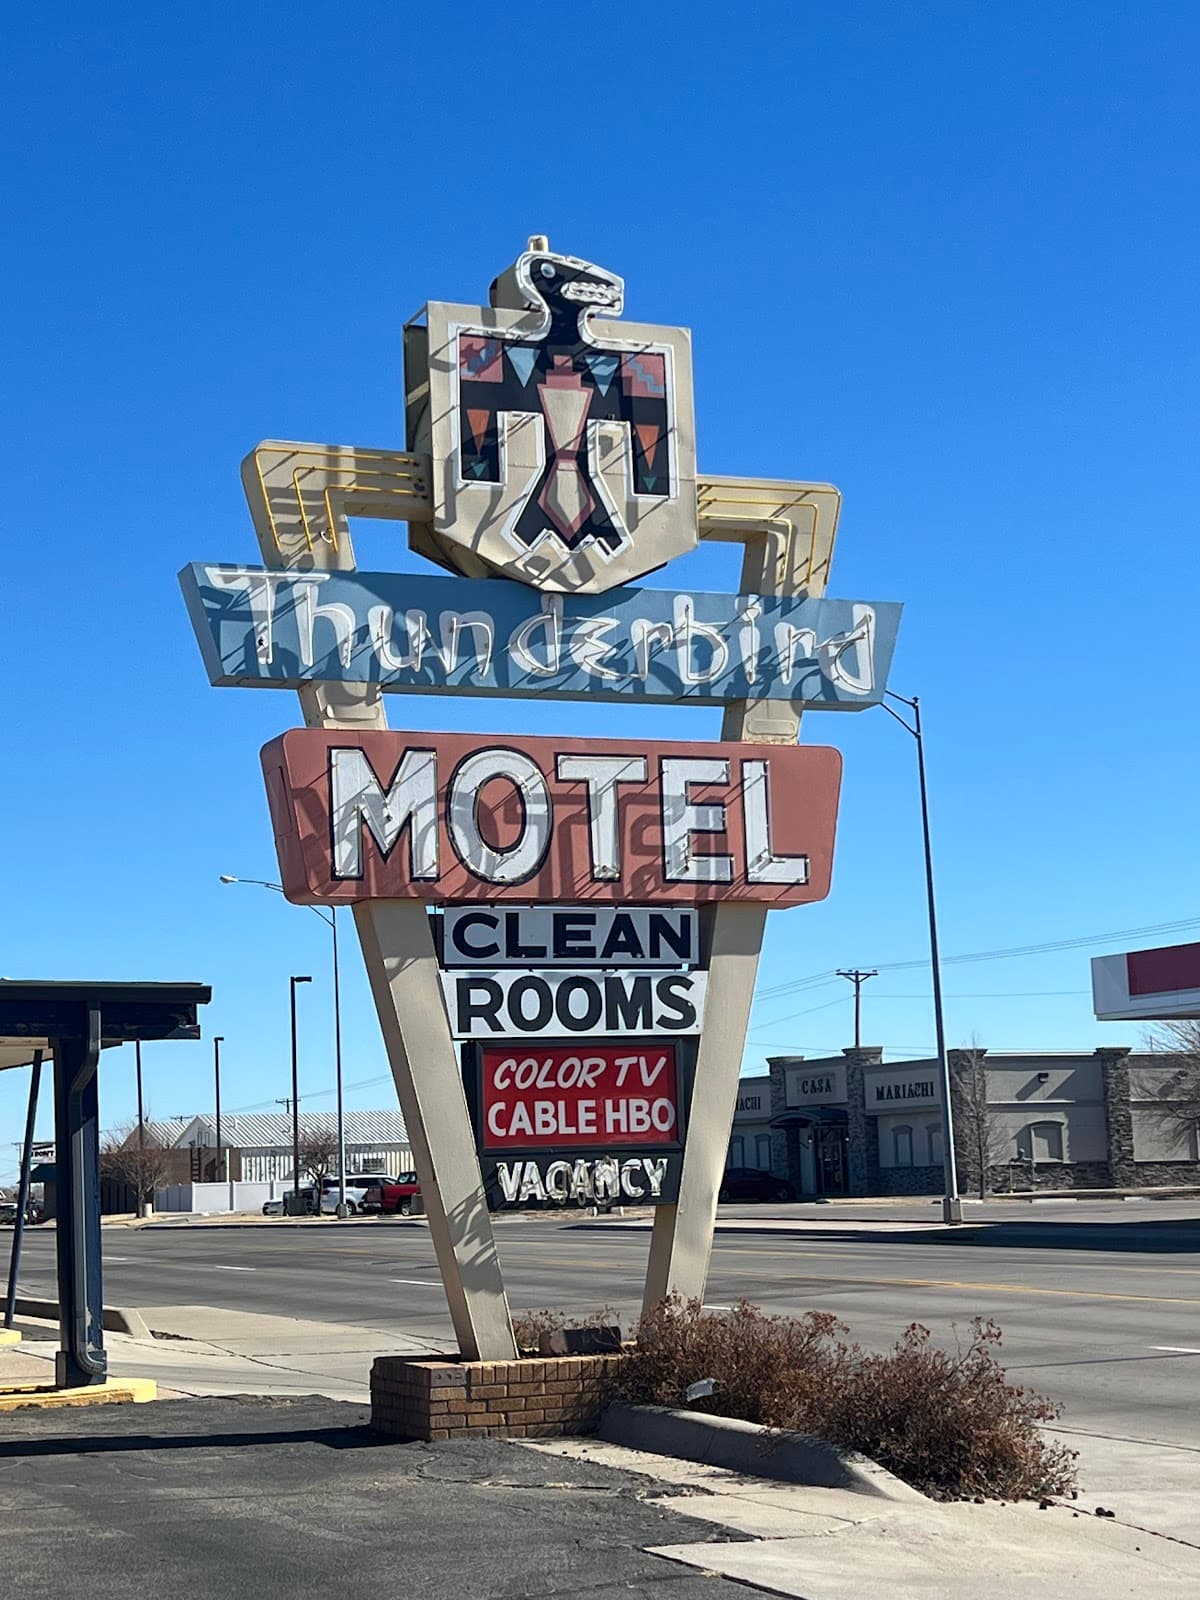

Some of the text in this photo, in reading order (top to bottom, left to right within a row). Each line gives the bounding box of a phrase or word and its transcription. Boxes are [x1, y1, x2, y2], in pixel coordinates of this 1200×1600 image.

[203, 566, 878, 694] Thunderbird
[329, 746, 809, 884] MOTEL
[452, 912, 691, 959] CLEAN
[456, 975, 697, 1033] ROOMS
[493, 1056, 667, 1090] COLOR TV
[802, 1078, 832, 1095] CASA
[876, 1081, 934, 1100] MARIACHI
[487, 1097, 676, 1137] CABLE HBO
[496, 1158, 668, 1202] VACANCY
